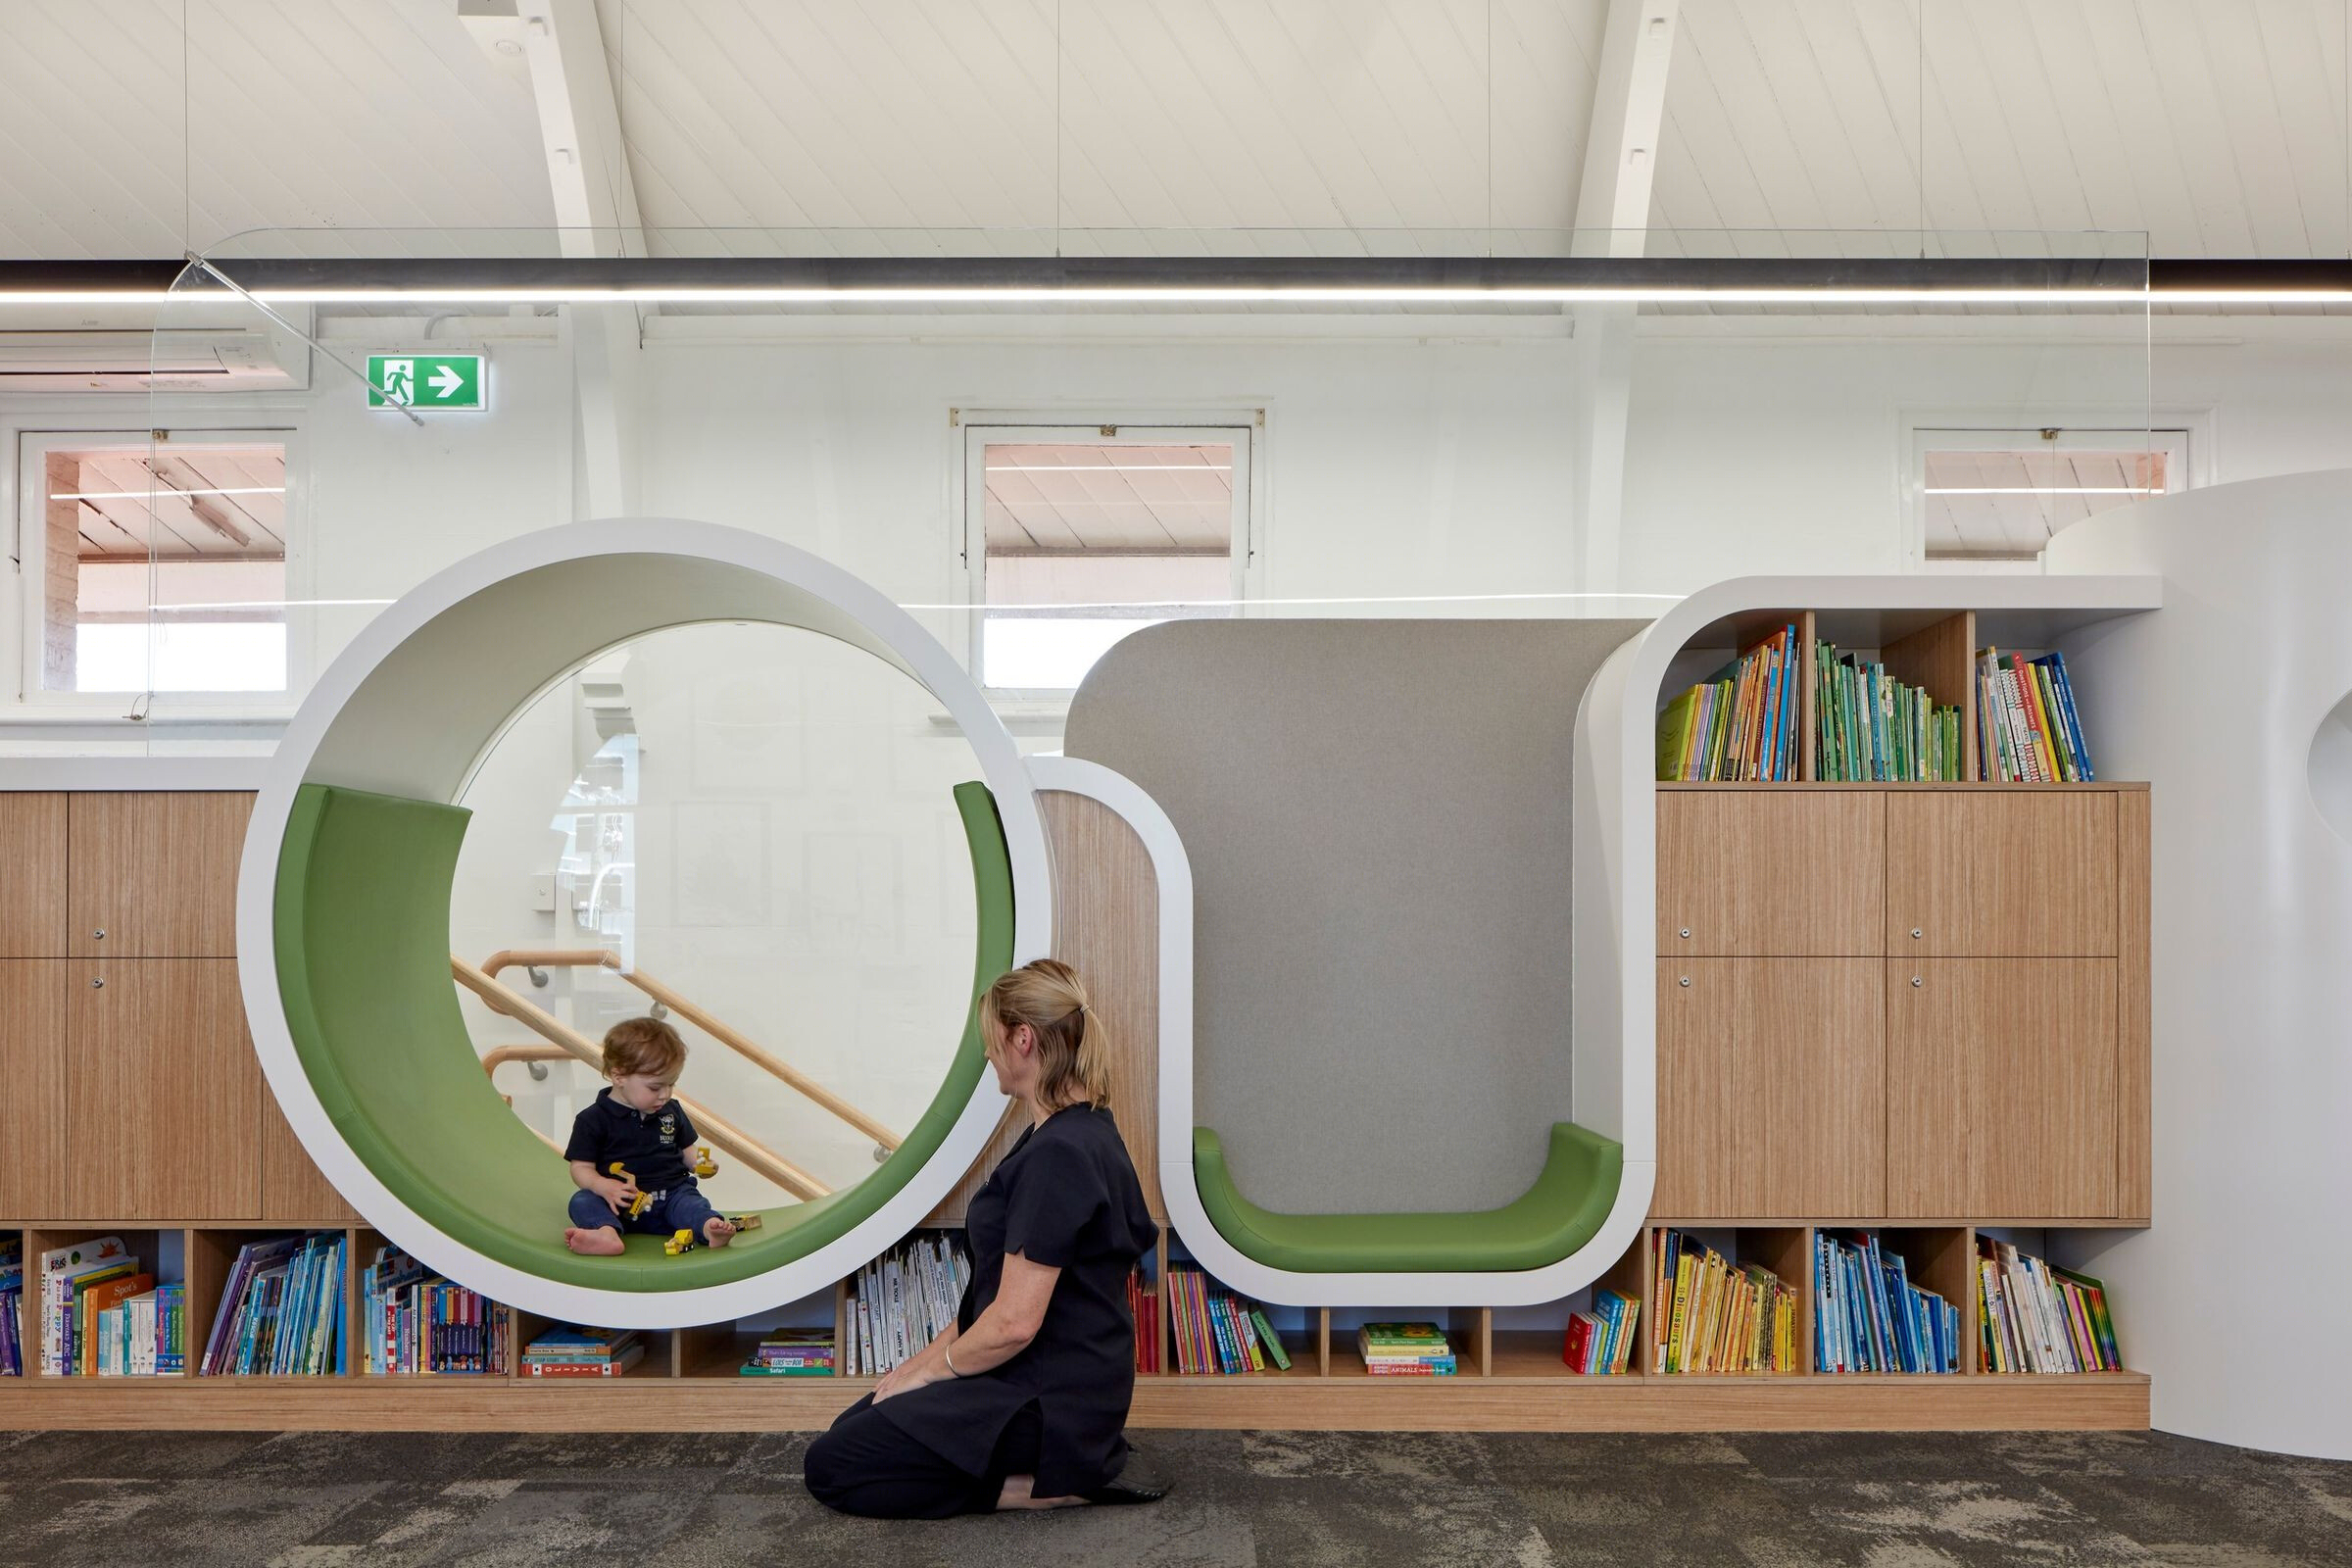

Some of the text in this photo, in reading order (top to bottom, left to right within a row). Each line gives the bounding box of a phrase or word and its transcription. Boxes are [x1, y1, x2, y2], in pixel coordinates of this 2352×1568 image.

[2019, 670, 2028, 698] Questions
[2027, 704, 2036, 729] Answers
[114, 1282, 137, 1297] Spot's
[1672, 1297, 1685, 1344] Dinosaurs
